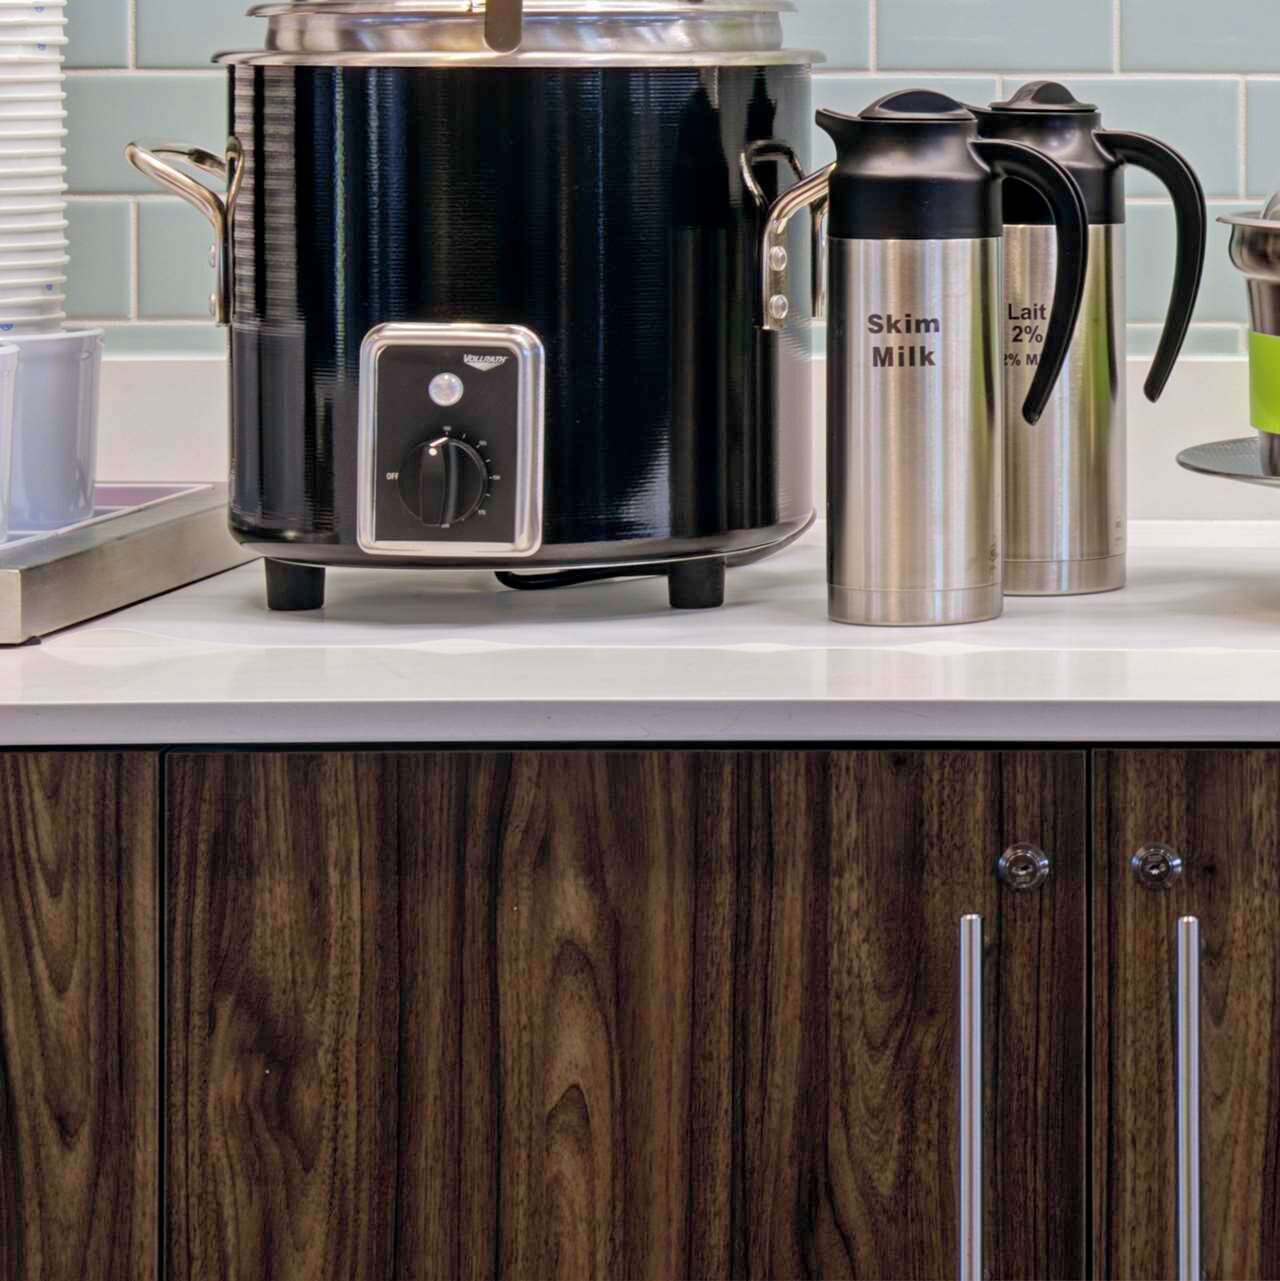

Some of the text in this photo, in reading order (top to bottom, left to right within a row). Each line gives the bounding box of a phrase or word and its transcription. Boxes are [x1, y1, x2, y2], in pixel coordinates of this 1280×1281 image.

[1008, 303, 1047, 320] Lait
[867, 314, 941, 334] Skim
[1012, 325, 1043, 344] 2%
[872, 346, 936, 367] Milk
[386, 472, 400, 480] OFF
